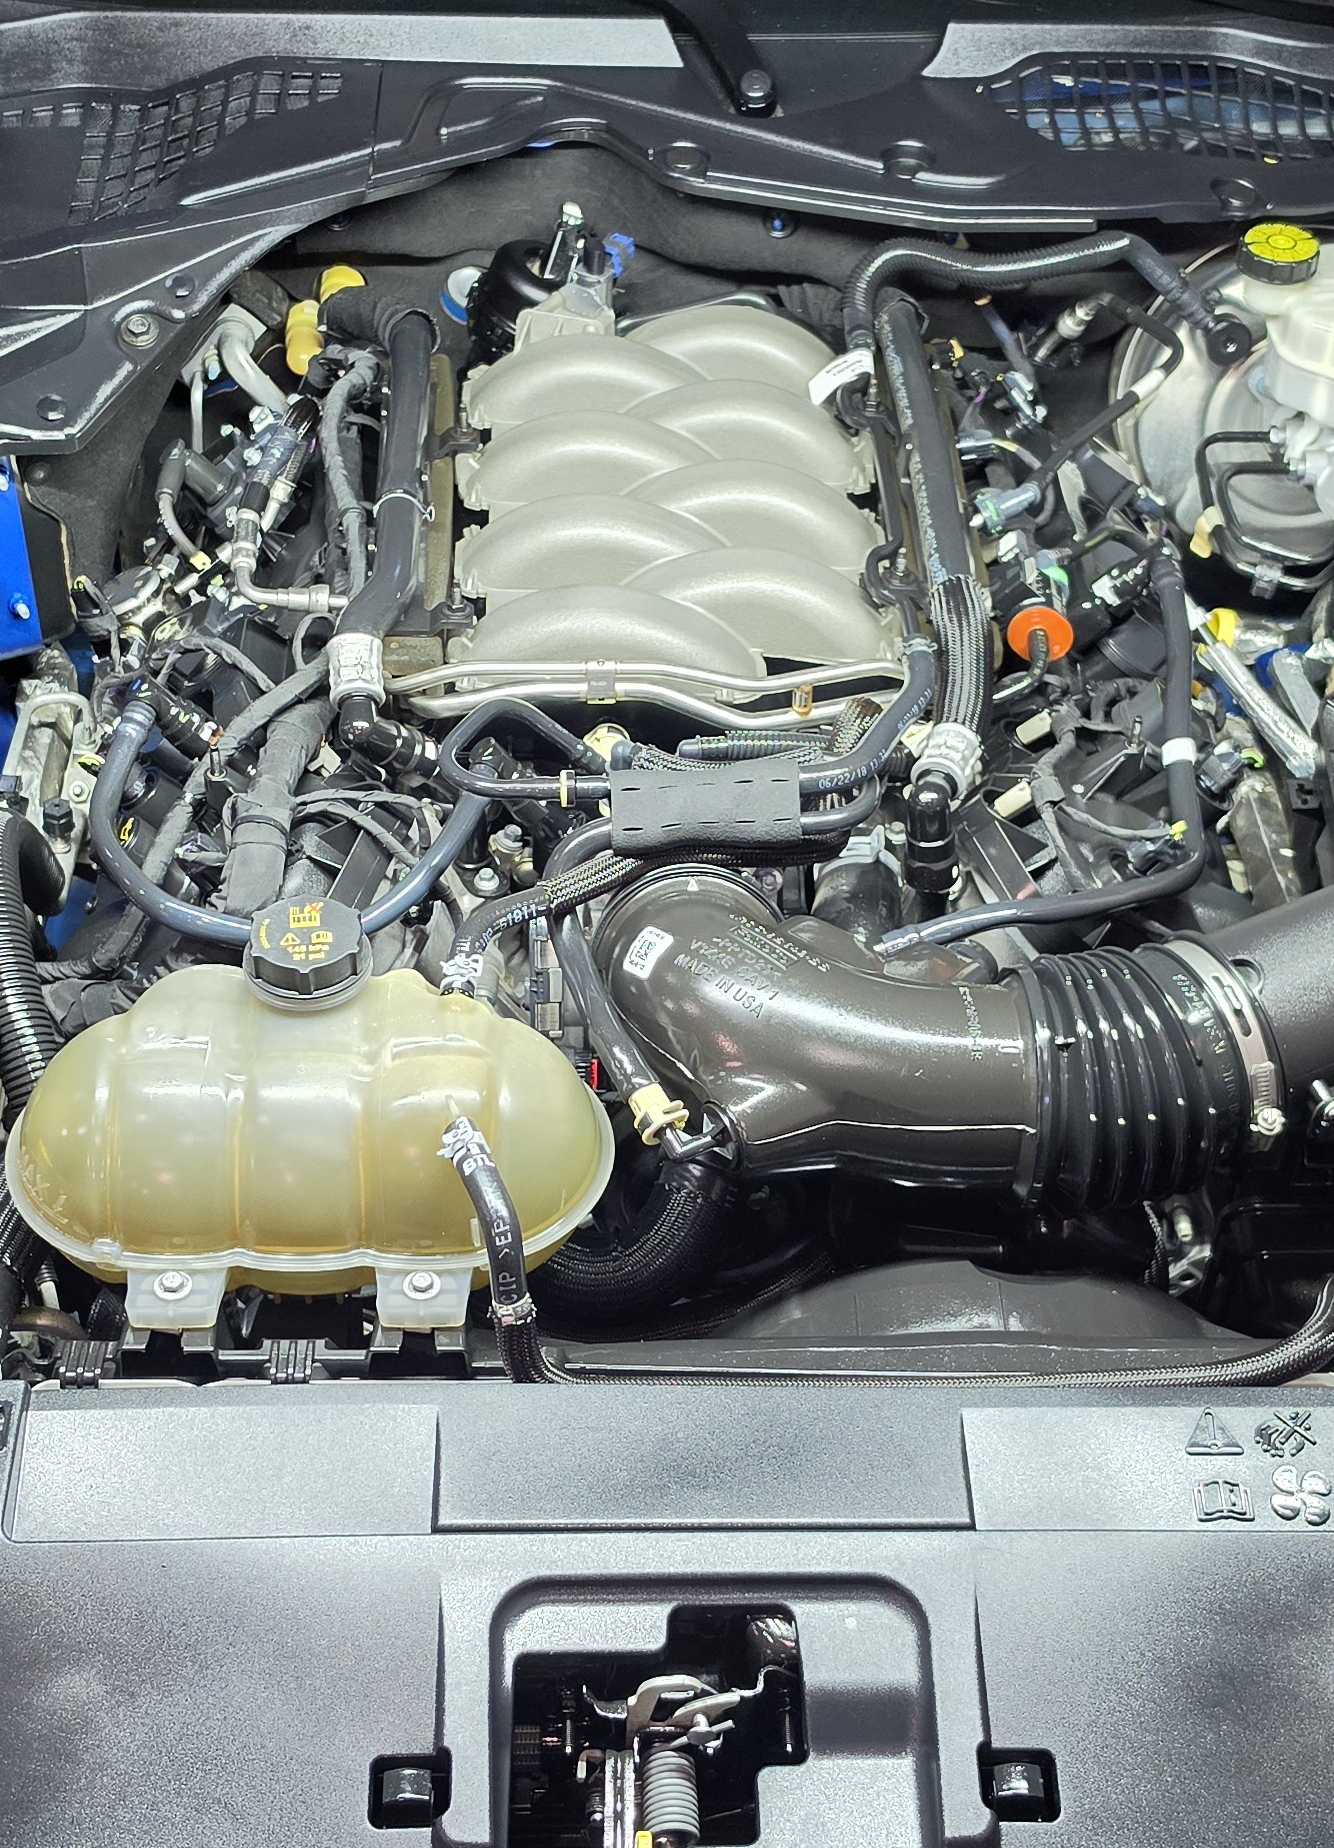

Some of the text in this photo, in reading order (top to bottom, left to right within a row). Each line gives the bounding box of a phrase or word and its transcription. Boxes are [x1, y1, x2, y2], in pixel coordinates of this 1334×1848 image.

[818, 765, 867, 789] 06/22/18
[673, 953, 716, 982] MADE
[715, 977, 735, 994] IN
[732, 987, 764, 1019] USA
